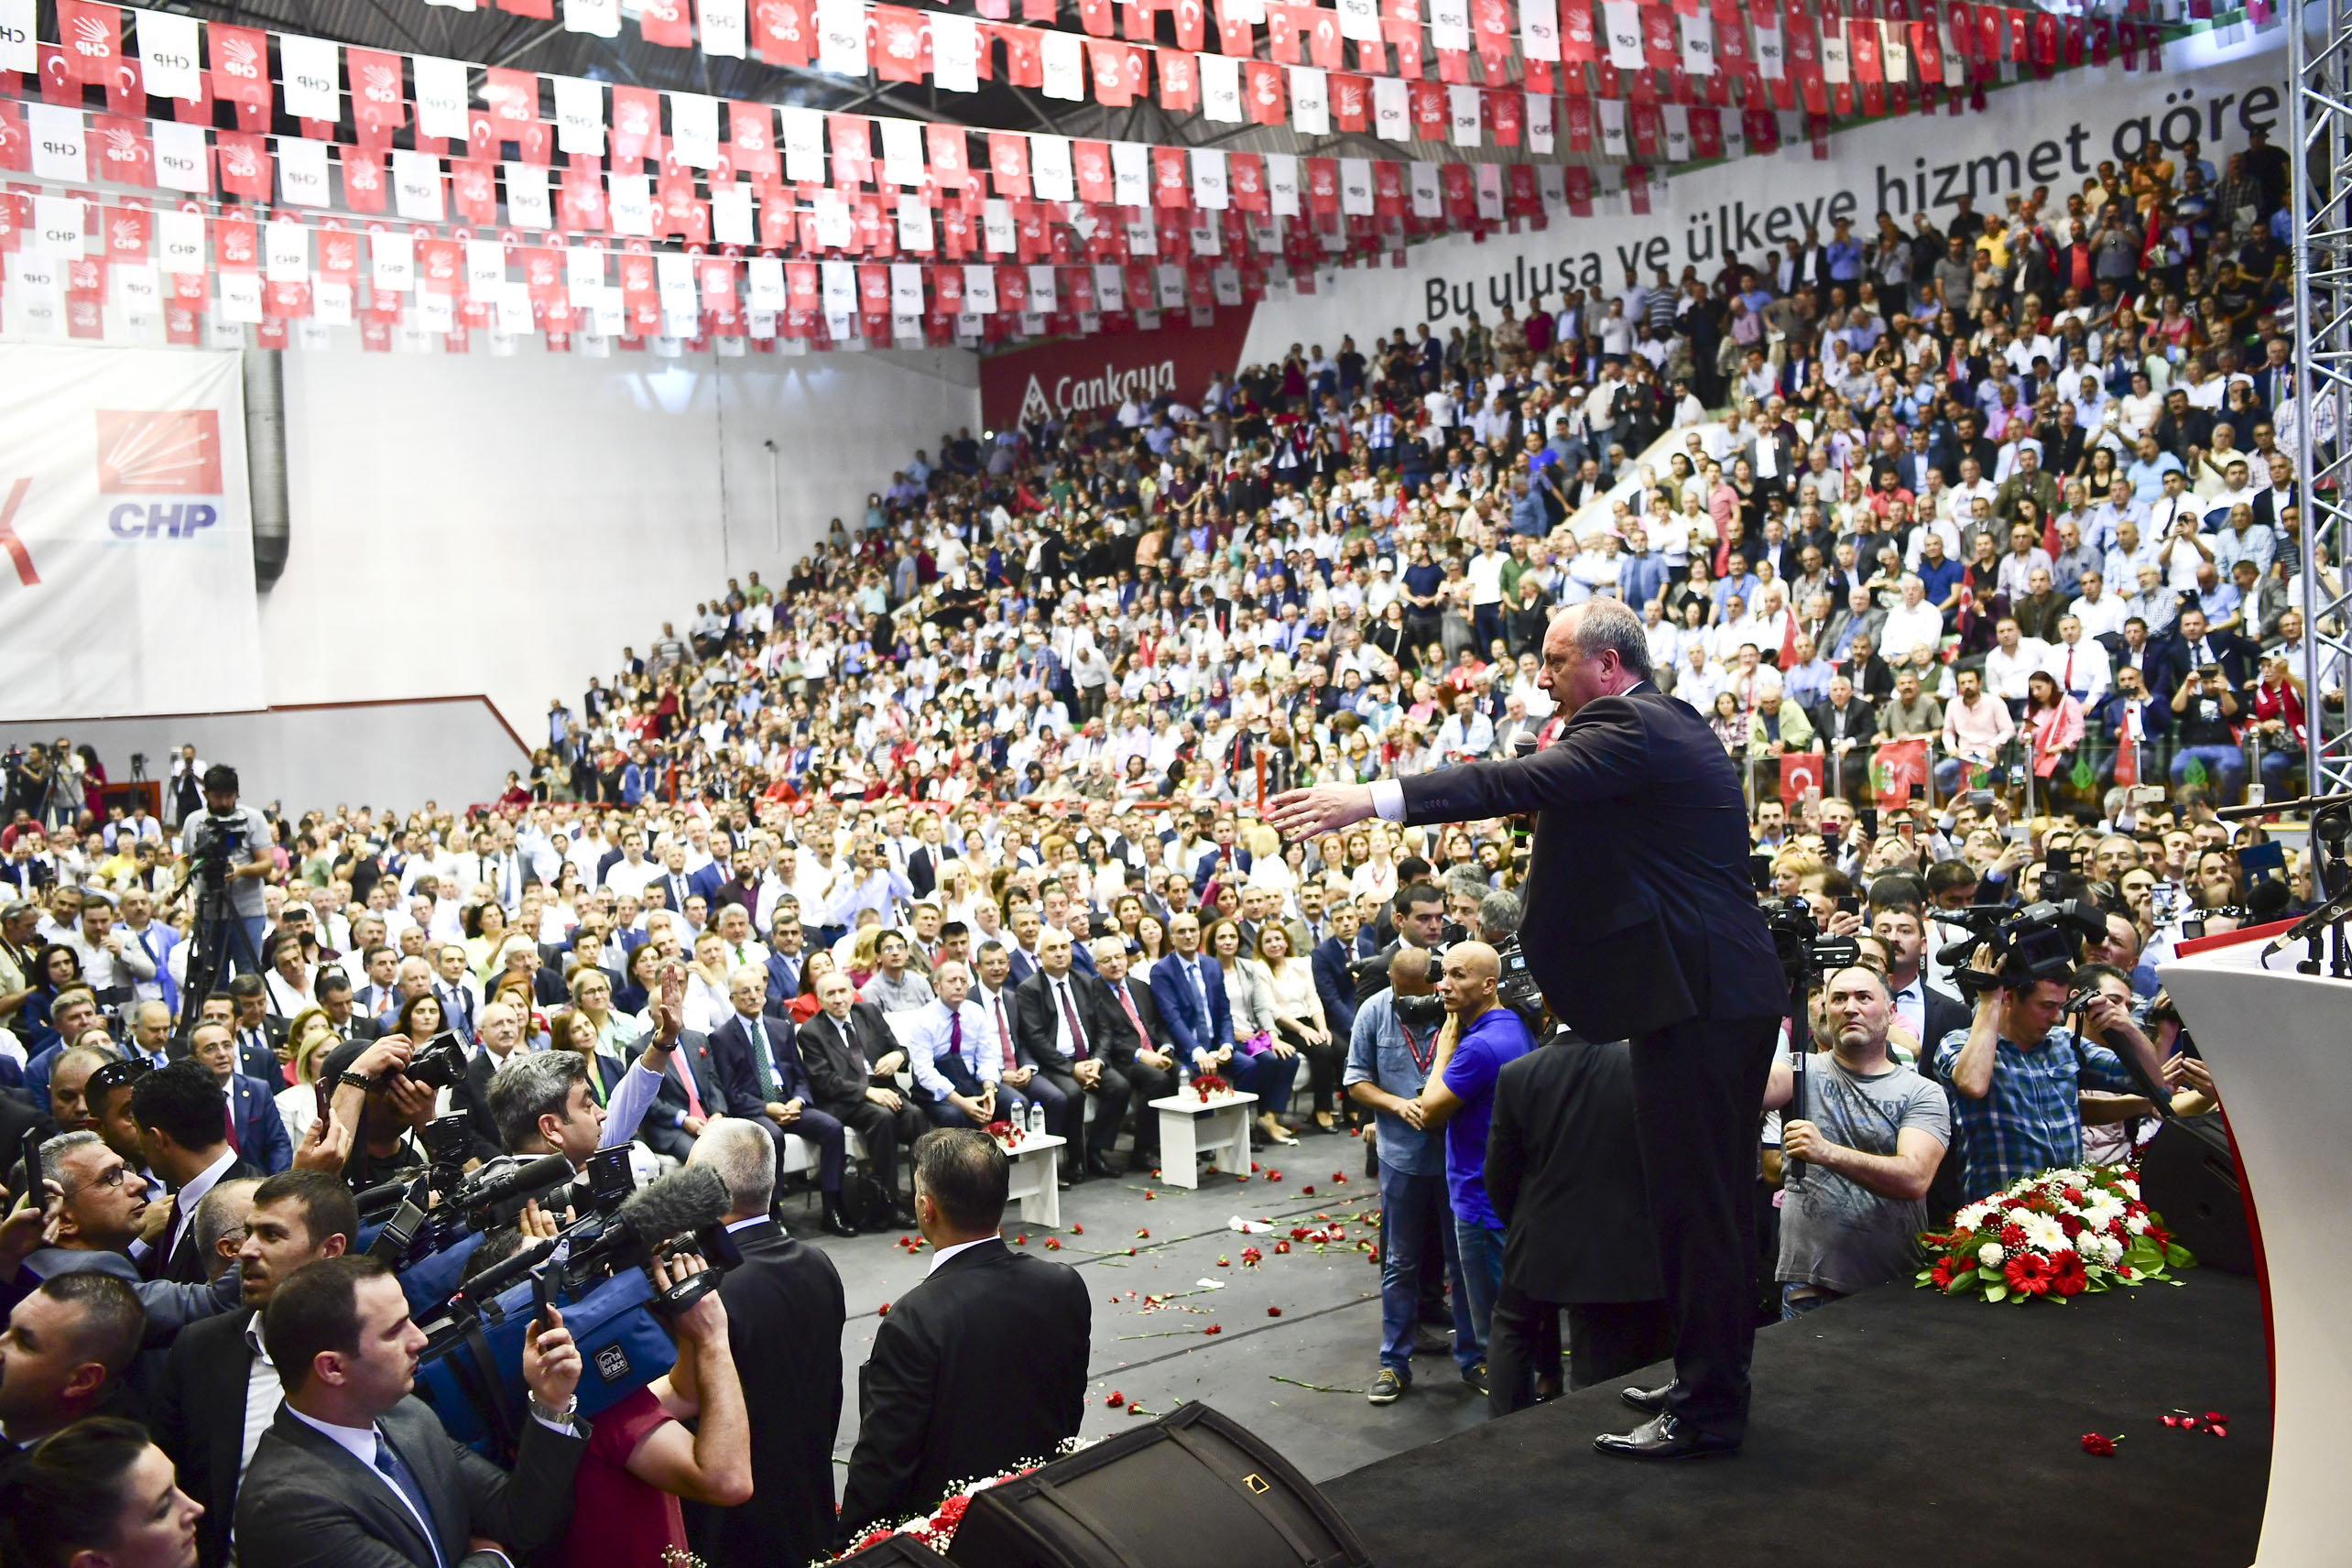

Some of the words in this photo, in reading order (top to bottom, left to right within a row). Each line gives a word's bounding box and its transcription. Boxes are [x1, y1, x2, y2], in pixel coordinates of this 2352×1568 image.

[1457, 116, 1475, 126] CHP
[1426, 278, 1475, 321] Bu
[1489, 252, 1602, 308] ulusa
[1617, 236, 1671, 274] ve
[1686, 191, 1857, 263] ülkeye
[1877, 123, 2091, 215] hizmet
[46, 231, 75, 242] CHP
[114, 238, 141, 250] CHP
[169, 244, 196, 255] CHP
[225, 249, 251, 261] CHP
[275, 255, 300, 265] CHP
[381, 264, 405, 273] CHP
[1055, 360, 1176, 420] Çankaya
[108, 503, 217, 539] CHP
[671, 1279, 700, 1299] Canon
